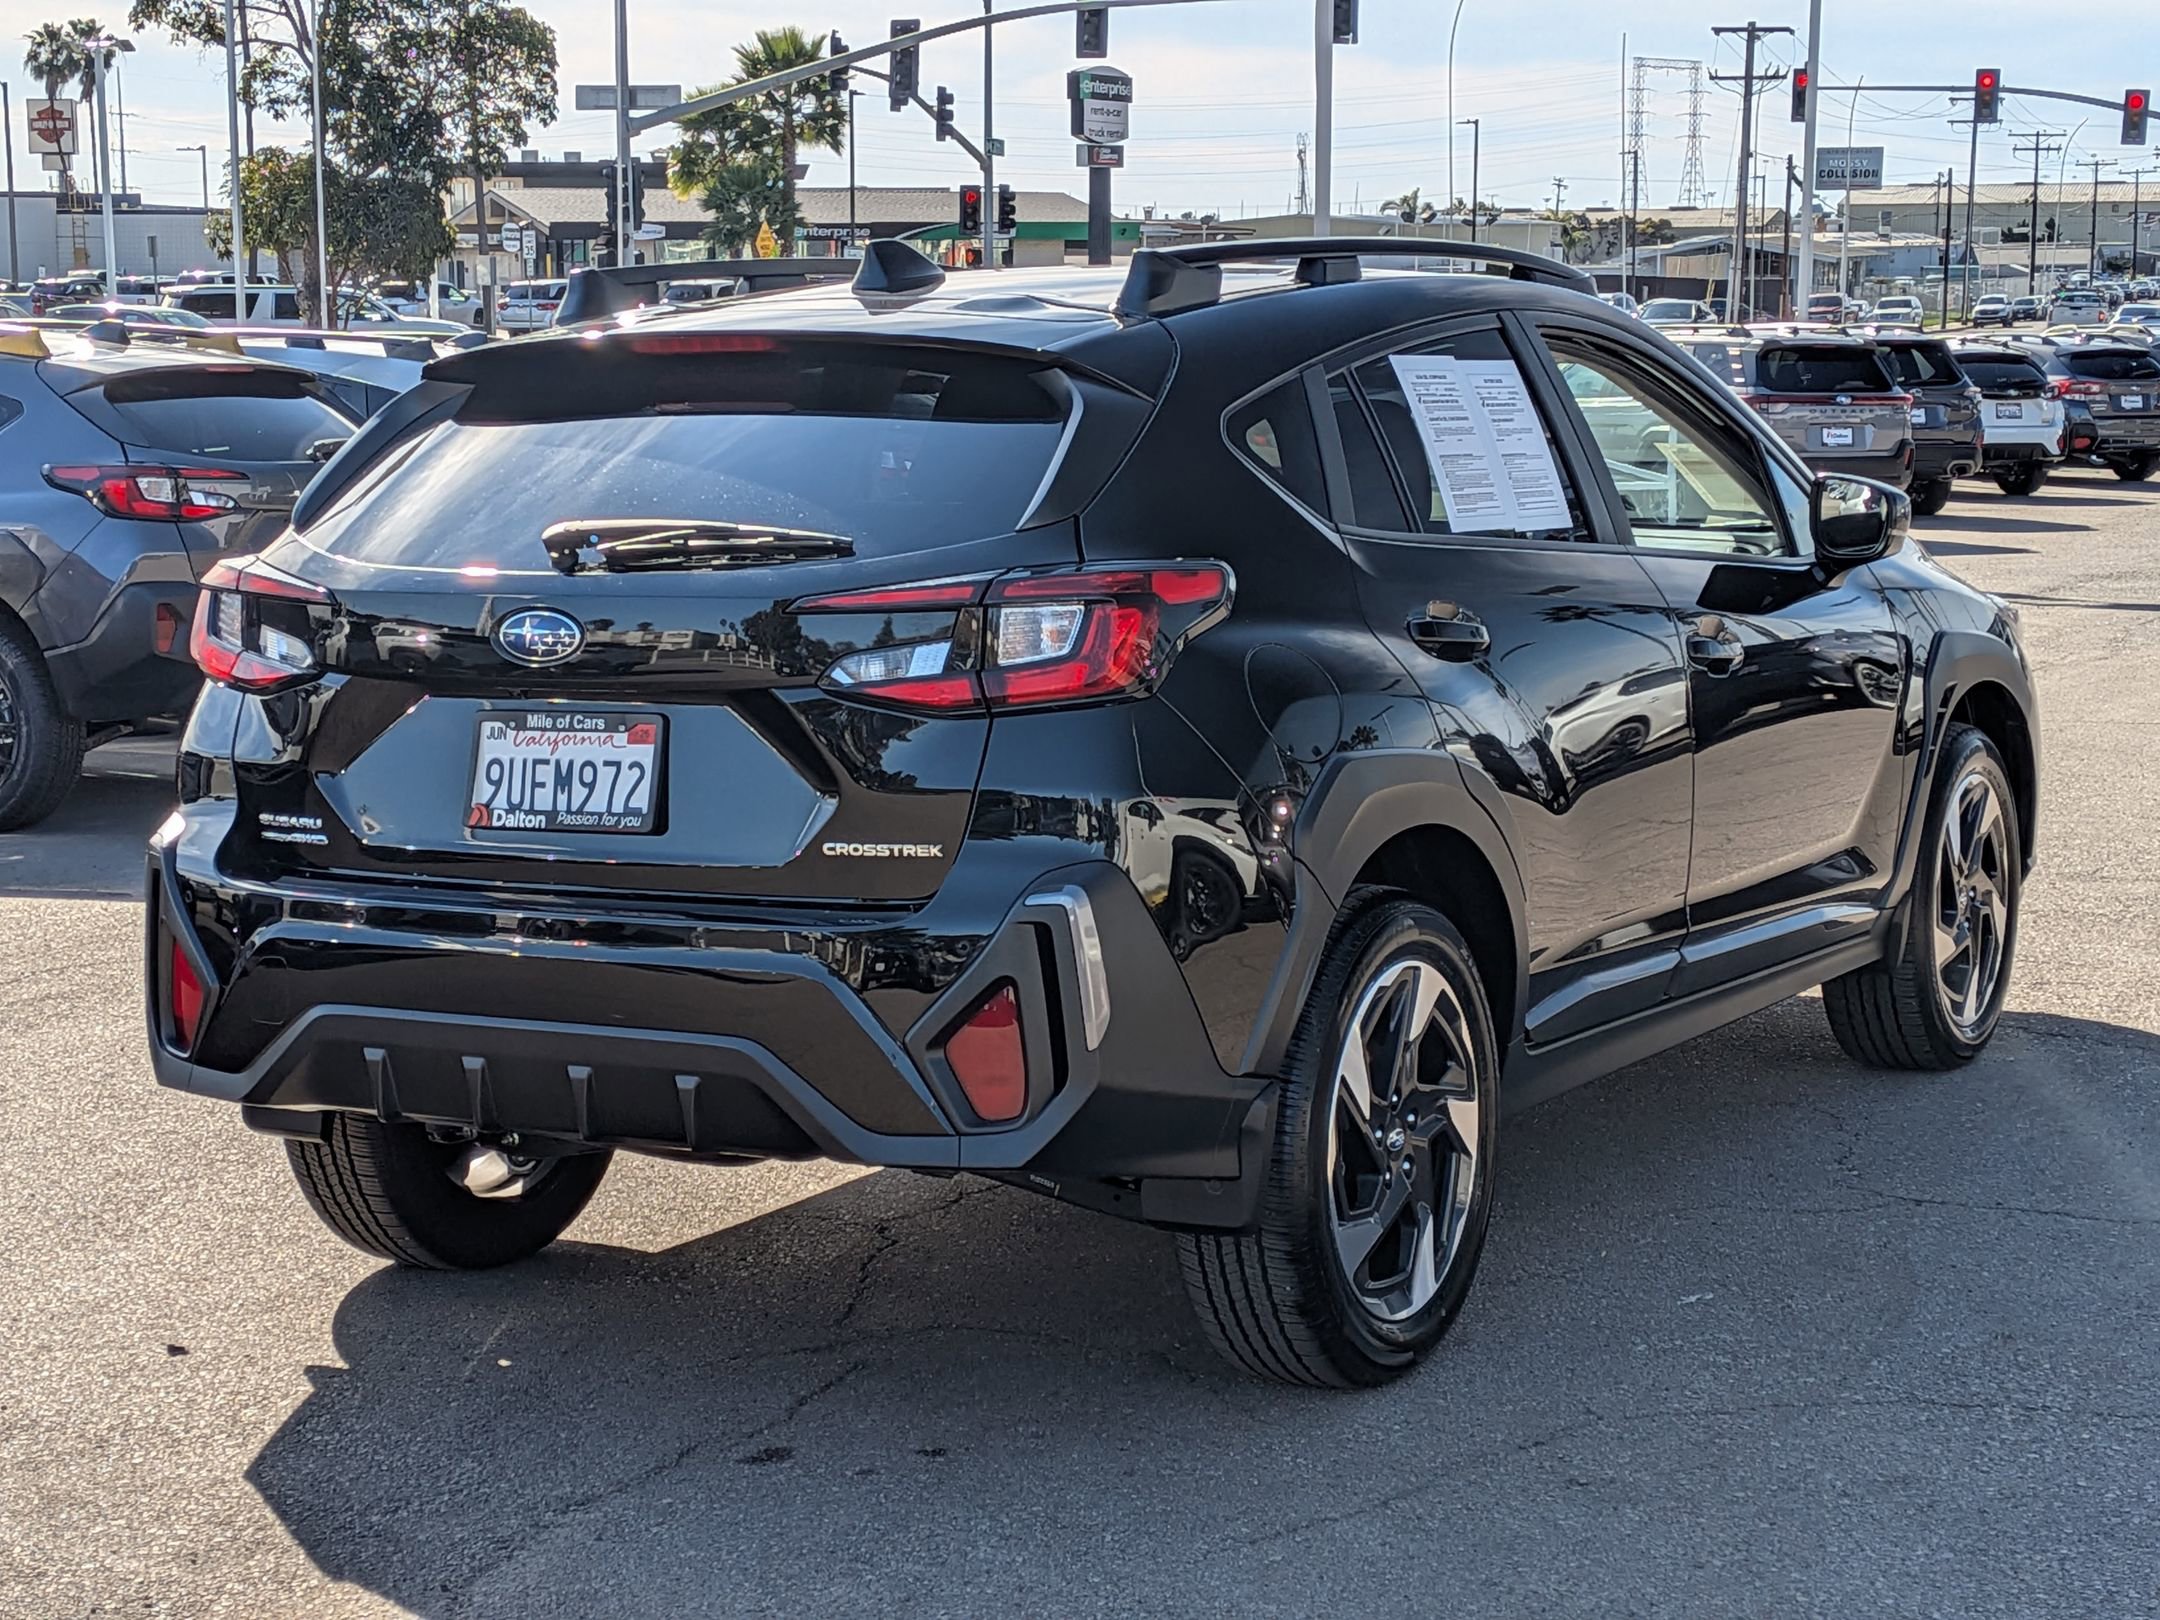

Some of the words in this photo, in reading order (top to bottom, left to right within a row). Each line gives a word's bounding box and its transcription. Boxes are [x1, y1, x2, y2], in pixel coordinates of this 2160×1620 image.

[1083, 80, 1131, 98] enterprise
[1088, 126, 1105, 137] truck
[1819, 169, 1879, 178] COLLSION
[525, 246, 535, 256] 35
[527, 714, 552, 728] Mile
[556, 715, 571, 729] of
[573, 715, 606, 730] Cars
[487, 727, 508, 740] JUN
[513, 729, 627, 756] California
[485, 757, 647, 813] 9UFM972
[492, 809, 546, 828] Dalton
[557, 812, 599, 826] Passion
[600, 813, 618, 827] for
[620, 817, 643, 829] you
[822, 842, 943, 857] CROSSTREK
